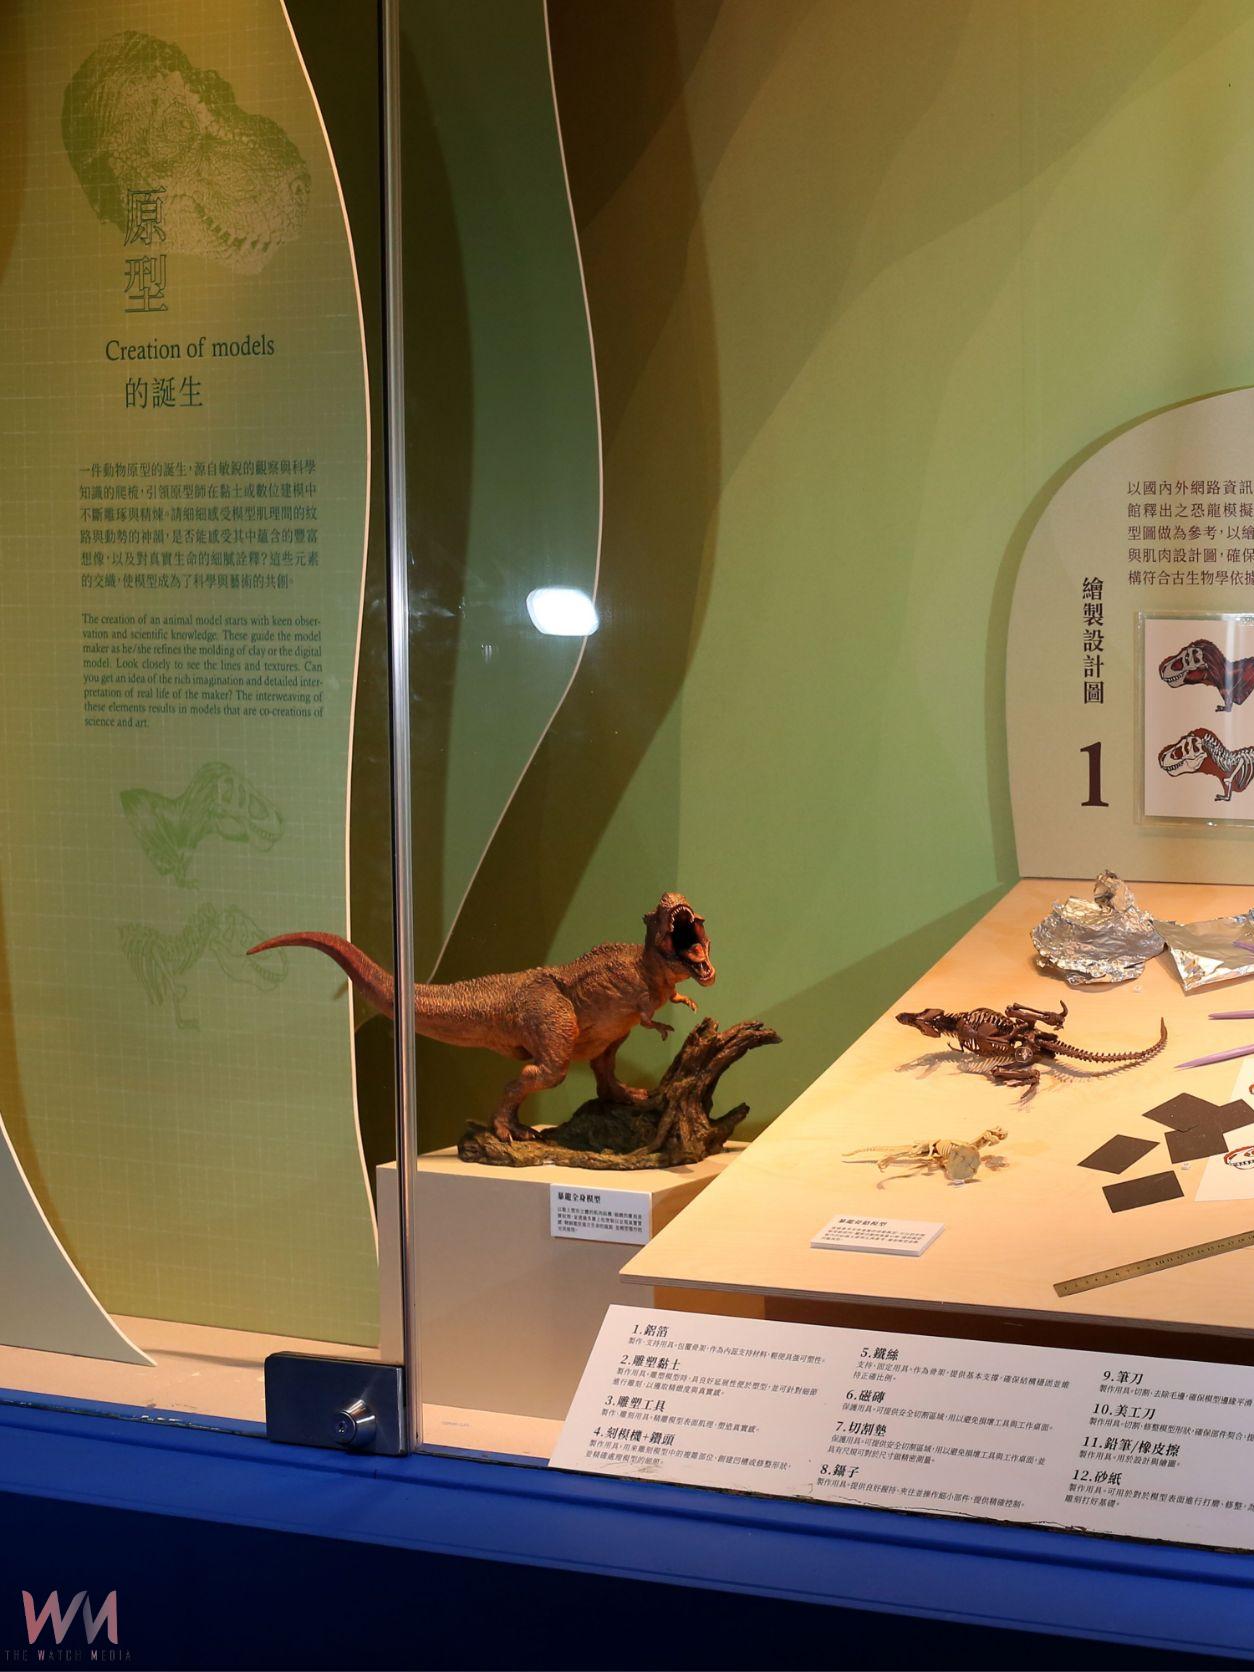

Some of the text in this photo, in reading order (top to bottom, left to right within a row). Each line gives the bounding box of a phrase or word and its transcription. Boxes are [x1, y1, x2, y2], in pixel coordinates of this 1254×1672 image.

[124, 186, 168, 313] 原型
[105, 335, 275, 361] Creation of models
[125, 376, 203, 408] 的誕生
[82, 614, 320, 626] The creation of an animal model starts with keen obser-
[83, 629, 321, 643] vation and scientific knowledge. These guide the model
[1082, 577, 1104, 704] 繪製設計圖
[83, 644, 321, 658] maker as he/she refines the molding of clay or the digital
[83, 659, 322, 672] model. Look closely to see the lines and textures. Can
[84, 676, 99, 685] you
[101, 674, 113, 685] get
[128, 675, 145, 684] idea
[148, 675, 157, 684] of
[159, 675, 172, 684] the
[174, 675, 191, 684] rich
[193, 676, 243, 687] imagination
[246, 676, 261, 685] and
[264, 677, 297, 686] detailed
[301, 677, 322, 686] inter-
[84, 688, 322, 702] pretation of real life of the maker? The interweaving of
[85, 702, 105, 712] these
[109, 703, 145, 712] elements
[149, 704, 175, 713] results
[179, 704, 186, 714] in
[190, 705, 220, 714] models
[224, 705, 240, 715] that
[259, 706, 310, 716] co-creations
[314, 707, 323, 717] of
[85, 717, 149, 727] science and art.
[1079, 741, 1109, 807] 1
[632, 1324, 669, 1338] 1.鋁箔
[860, 1347, 899, 1361] 5.鐵絲
[620, 1354, 681, 1371] 2.雕塑黏土
[1103, 1371, 1144, 1385] 9.筆刀
[605, 1395, 666, 1412] 3.雕塑工具
[846, 1389, 886, 1403] 6.磁磚
[1092, 1403, 1156, 1420] 10.美工刀
[836, 1421, 887, 1437] 7.切割墊
[1083, 1436, 1181, 1458] 11.鉛筆/橡皮擦
[820, 1464, 860, 1479] 8.鑷子
[1072, 1470, 1122, 1486] 12.砂紙
